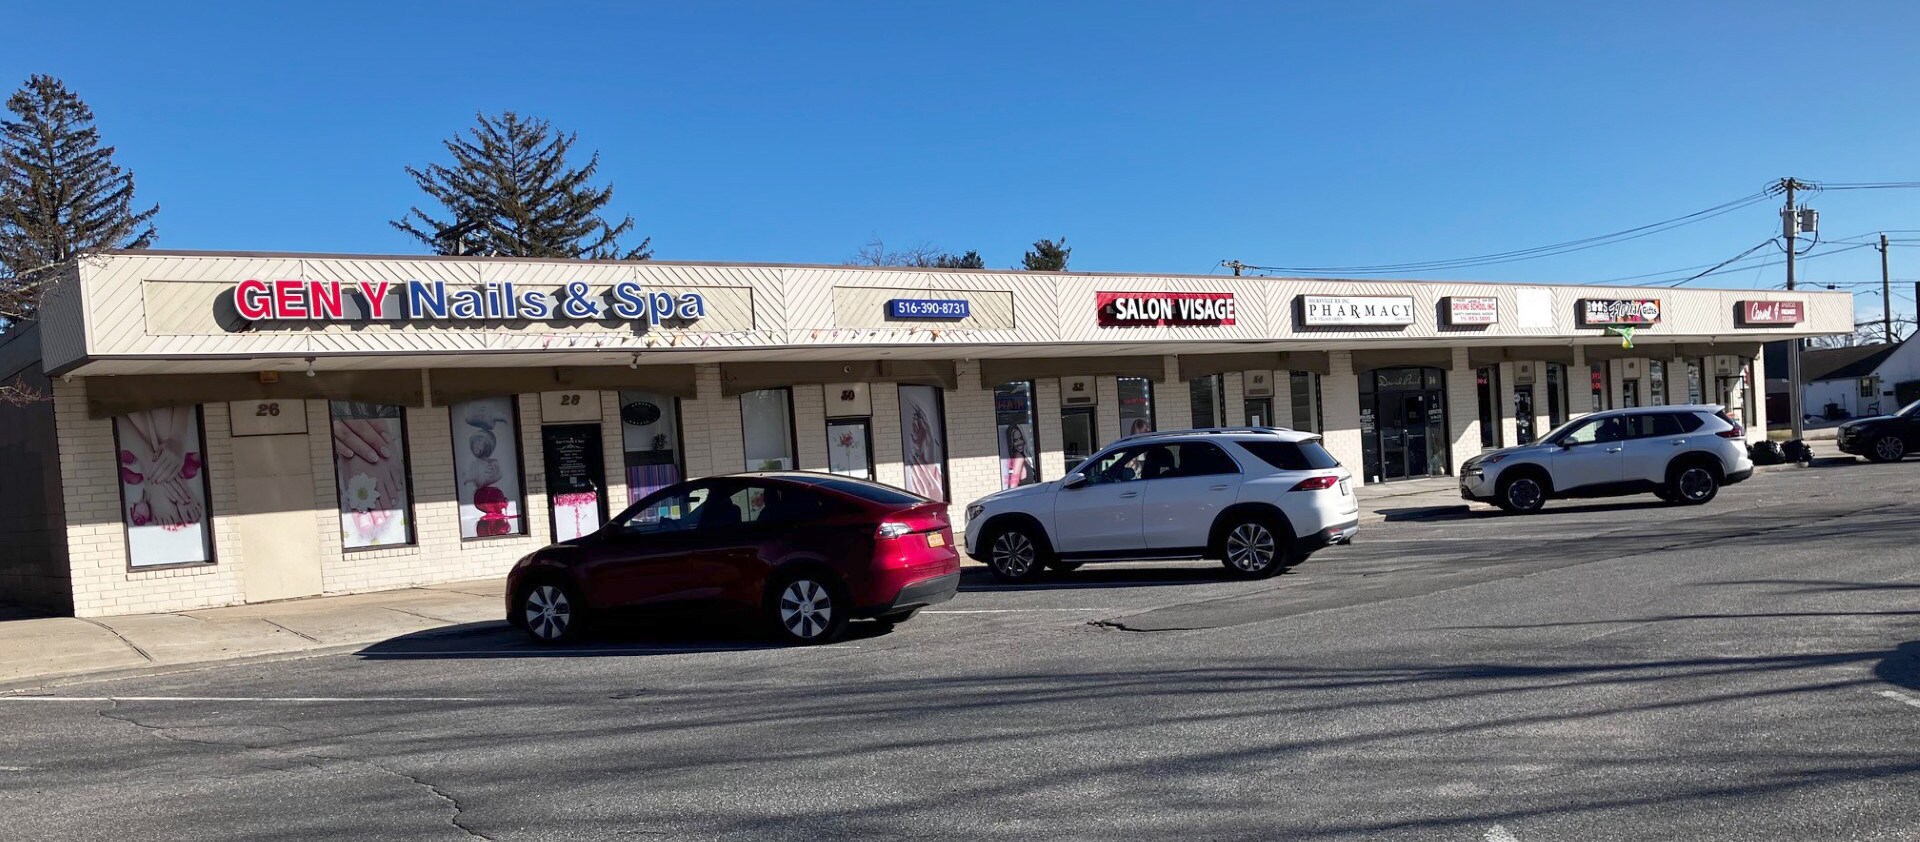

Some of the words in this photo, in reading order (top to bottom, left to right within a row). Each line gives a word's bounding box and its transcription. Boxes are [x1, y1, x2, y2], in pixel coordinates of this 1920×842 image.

[234, 279, 344, 320] GEN
[359, 281, 390, 319] Y
[406, 279, 549, 320] Nails
[563, 281, 601, 320] &
[613, 281, 706, 327] Spa
[898, 302, 966, 314] 516-390-8731
[1115, 297, 1172, 320] SALON
[1179, 298, 1235, 320] VISAGE
[1309, 304, 1411, 319] PHARMACY
[560, 394, 581, 406] 28
[256, 403, 280, 416] 26
